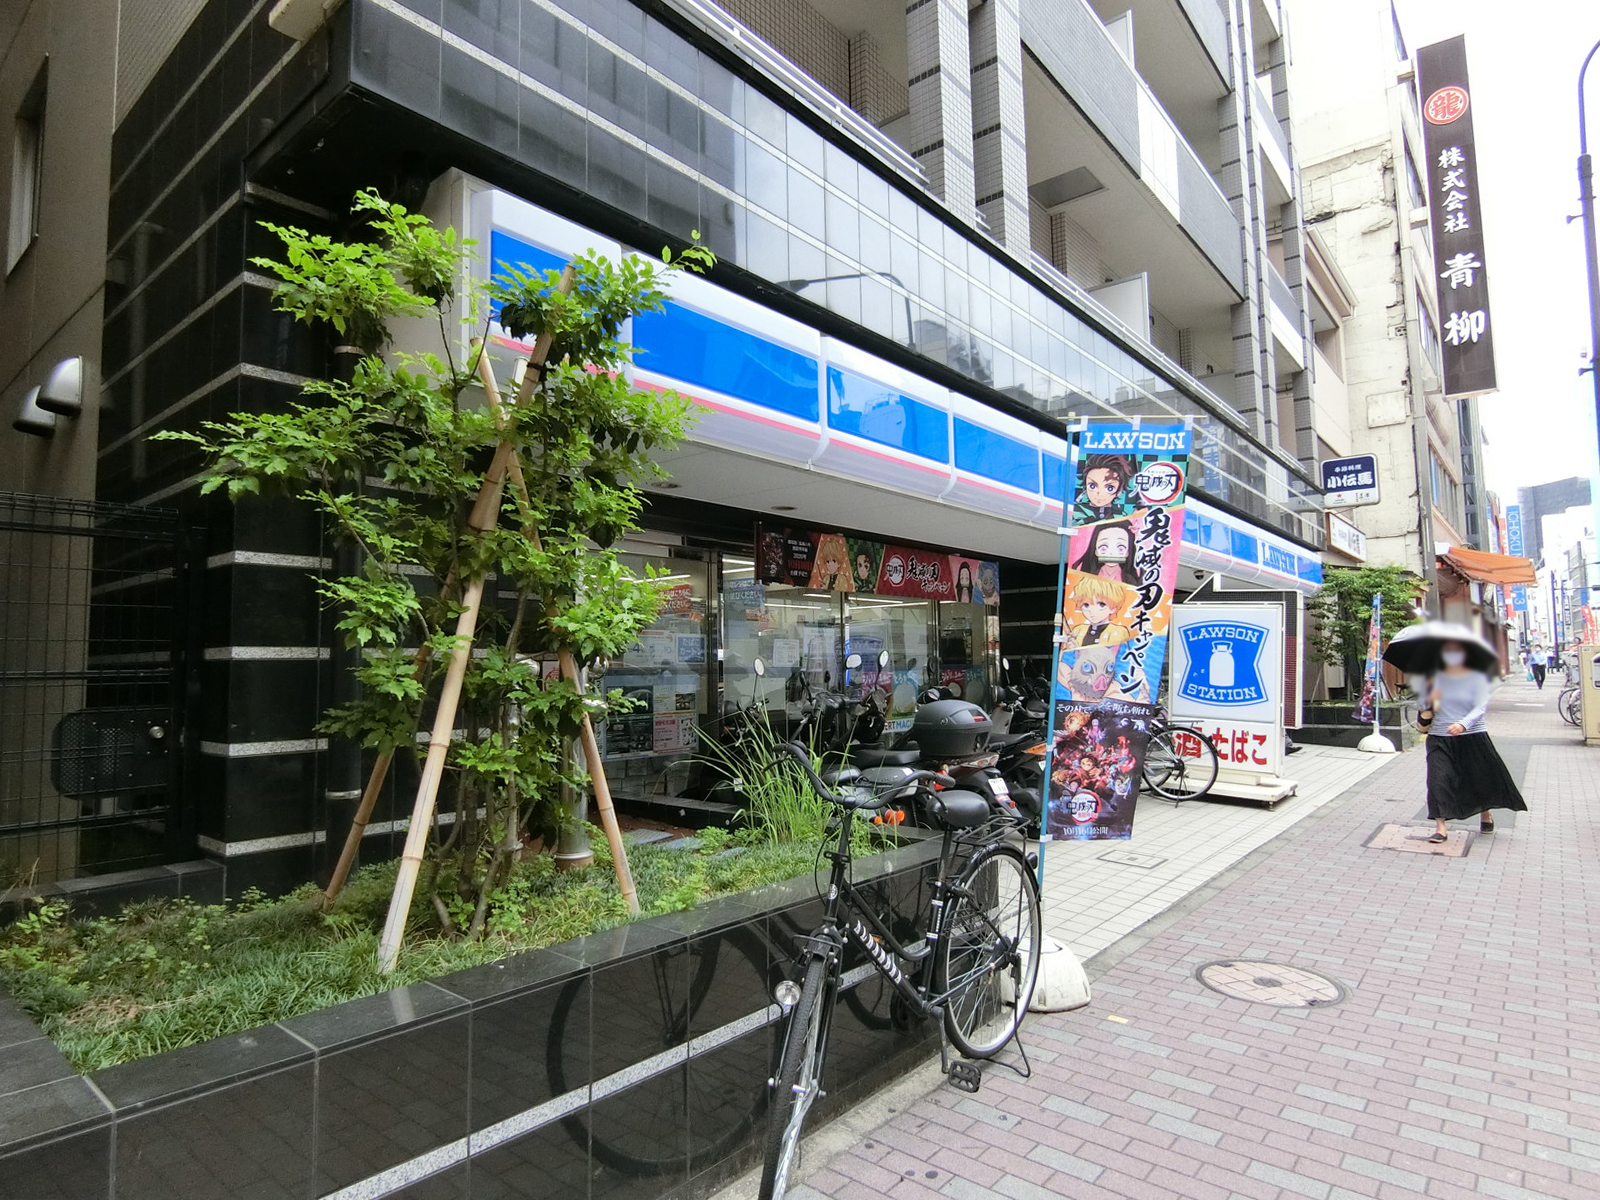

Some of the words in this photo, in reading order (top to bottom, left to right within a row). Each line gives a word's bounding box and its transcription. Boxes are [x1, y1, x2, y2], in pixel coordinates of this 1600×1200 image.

[1431, 92, 1461, 119] 龍
[1438, 146, 1469, 234] 株式会社
[1440, 253, 1485, 346] 青柳
[1084, 432, 1186, 450] LAWSON
[1327, 471, 1373, 489] 小伝馬
[1261, 541, 1296, 576] LAWSON
[1187, 627, 1259, 643] LAWSON
[1187, 683, 1257, 700] STATION
[1212, 727, 1267, 765] たばこ
